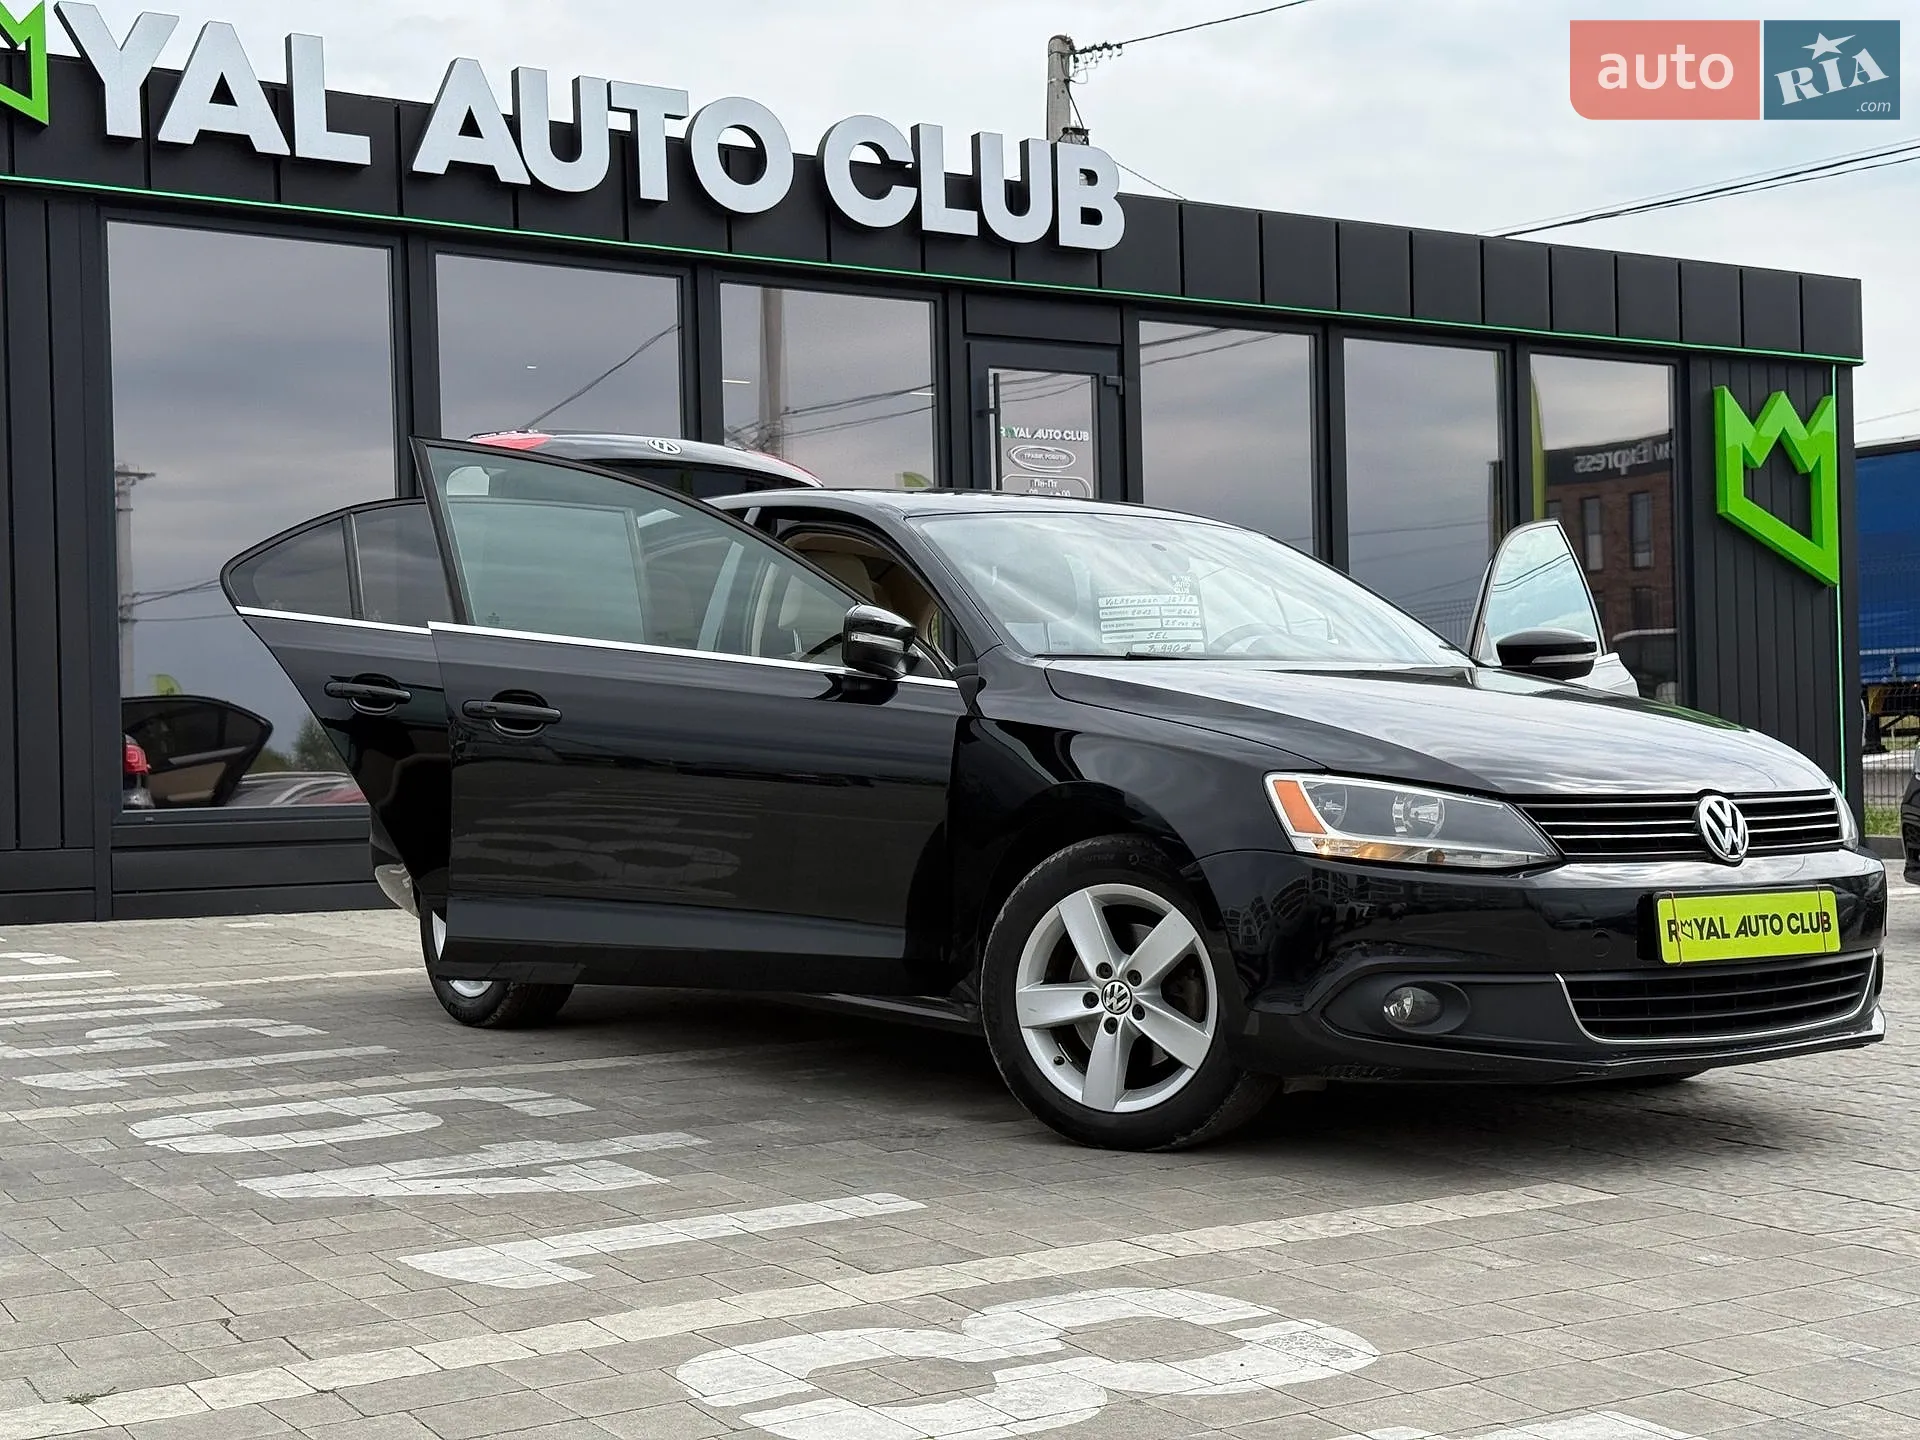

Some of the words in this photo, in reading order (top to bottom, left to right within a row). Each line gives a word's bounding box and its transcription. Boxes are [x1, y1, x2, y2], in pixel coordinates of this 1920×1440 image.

[412, 57, 795, 214] AUTO
[818, 114, 1126, 250] CLUB
[1033, 428, 1062, 440] AUTO
[1063, 430, 1089, 441] CLUB
[1734, 913, 1783, 938] AUTO
[1787, 911, 1832, 934] CLUB
